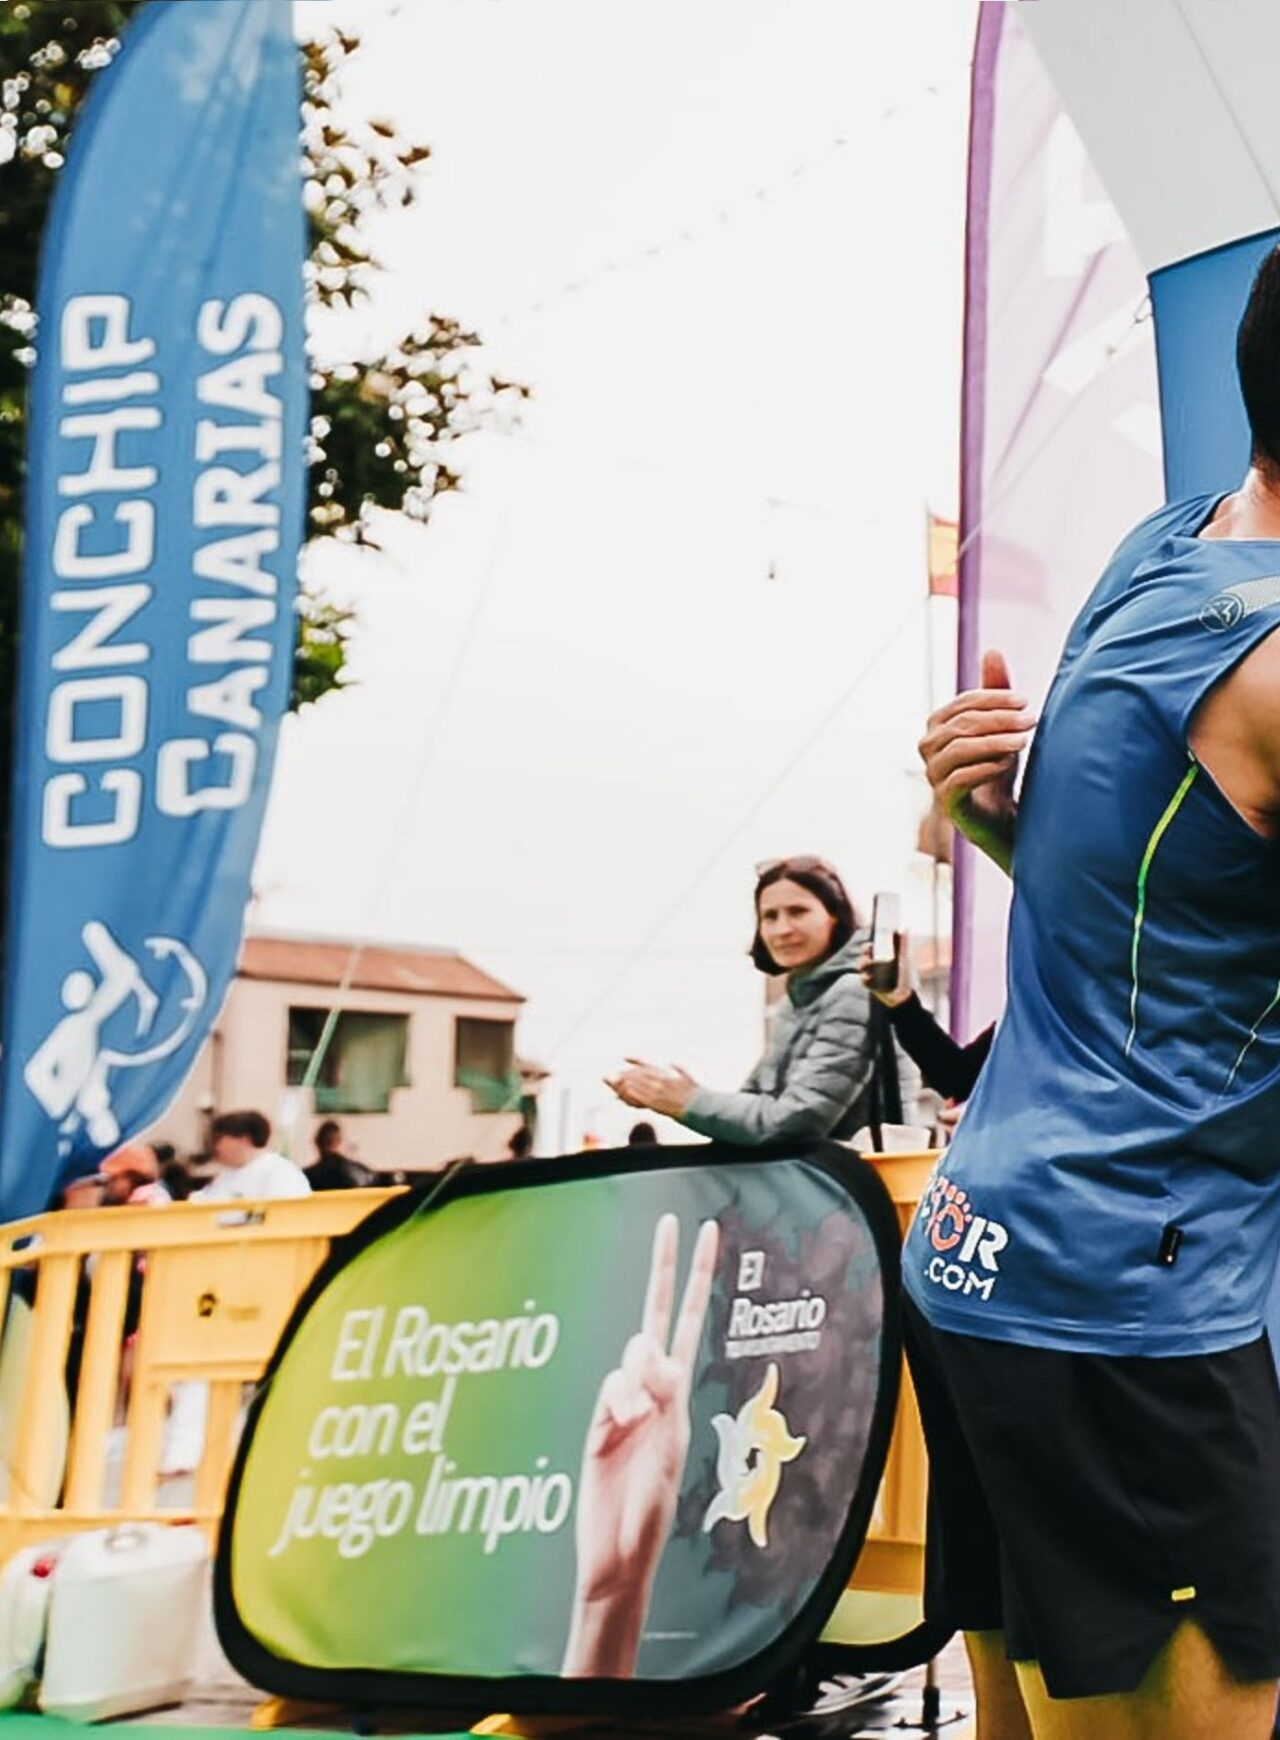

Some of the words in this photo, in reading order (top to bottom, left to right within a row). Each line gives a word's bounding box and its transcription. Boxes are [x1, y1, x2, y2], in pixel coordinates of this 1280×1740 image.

[42, 292, 159, 850] CONCHIP
[155, 291, 284, 817] CANARIAS
[738, 1250, 765, 1291] El
[923, 1256, 996, 1301] .COM
[330, 1305, 386, 1382] El
[382, 1299, 559, 1378] Rosario
[728, 1289, 826, 1338] Rosario
[308, 1402, 399, 1460] con
[402, 1375, 457, 1454] el
[267, 1468, 414, 1558] juego
[415, 1453, 572, 1554] limpio
